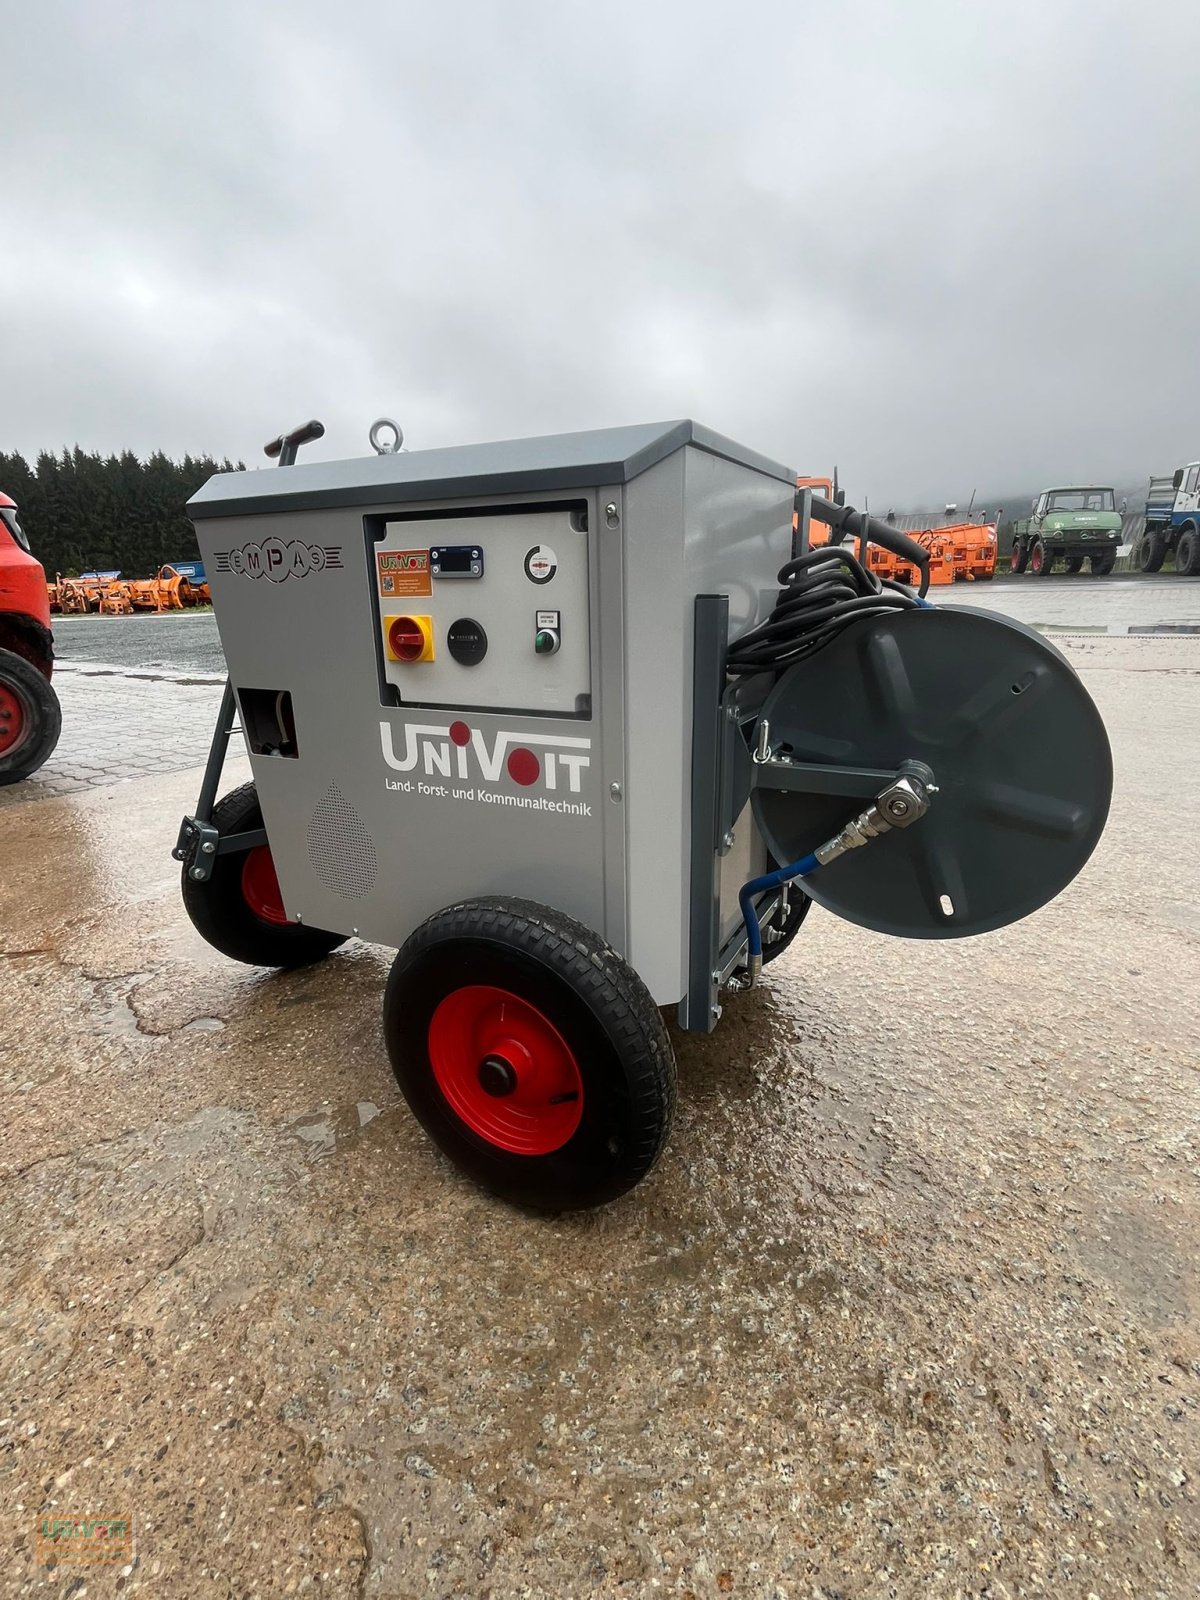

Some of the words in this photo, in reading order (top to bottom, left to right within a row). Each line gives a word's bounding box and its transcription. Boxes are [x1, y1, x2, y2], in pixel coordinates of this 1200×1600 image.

[234, 548, 320, 572] EMPAS
[385, 778, 415, 792] Land-
[417, 782, 449, 797] Forst-
[452, 788, 475, 801] und
[477, 790, 592, 816] Kommunaltechnik
